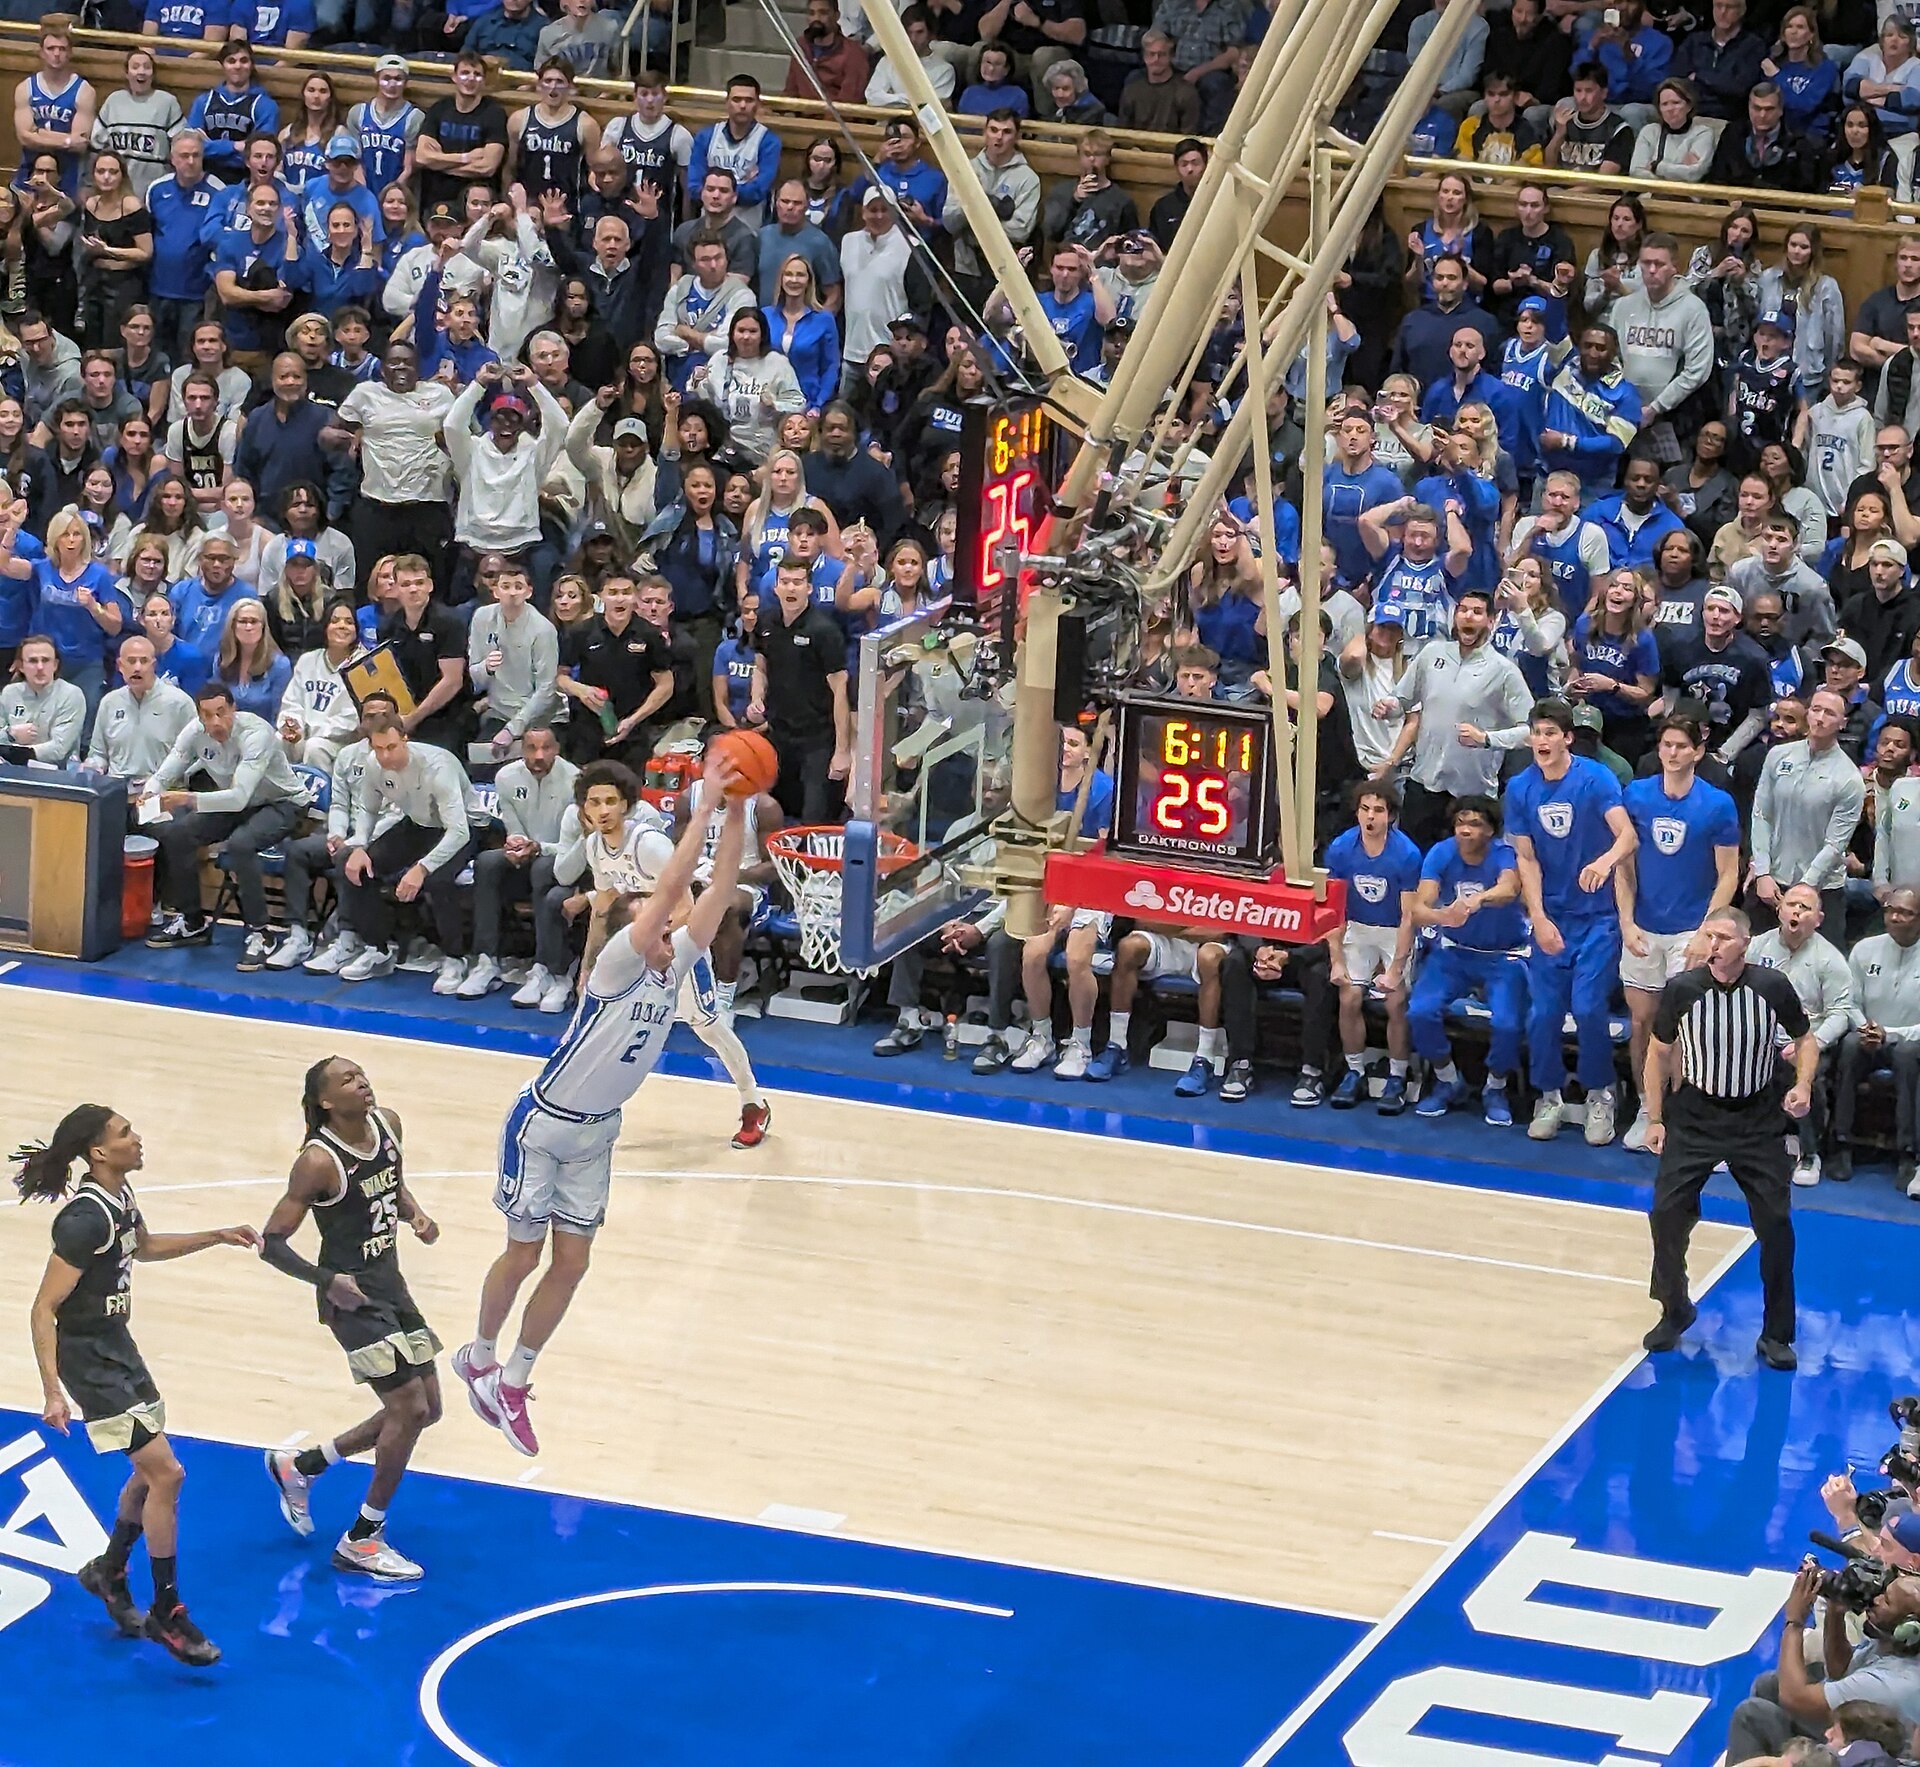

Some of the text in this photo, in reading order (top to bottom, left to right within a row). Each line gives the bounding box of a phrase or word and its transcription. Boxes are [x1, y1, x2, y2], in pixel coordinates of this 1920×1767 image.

[256, 6, 280, 31] D
[360, 132, 405, 154] DUKE
[374, 151, 382, 175] 1
[543, 154, 551, 180] 1
[623, 144, 665, 168] Duke
[1626, 325, 1675, 349] BOSCO
[1821, 450, 1835, 472] 2
[305, 680, 338, 697] DUK
[1886, 698, 1920, 717] DUK
[1164, 721, 1252, 772] 6:11
[1156, 773, 1228, 835] 25
[1138, 833, 1238, 856] DAKTRONICS
[620, 1029, 651, 1063] 2
[369, 1191, 398, 1234] 25
